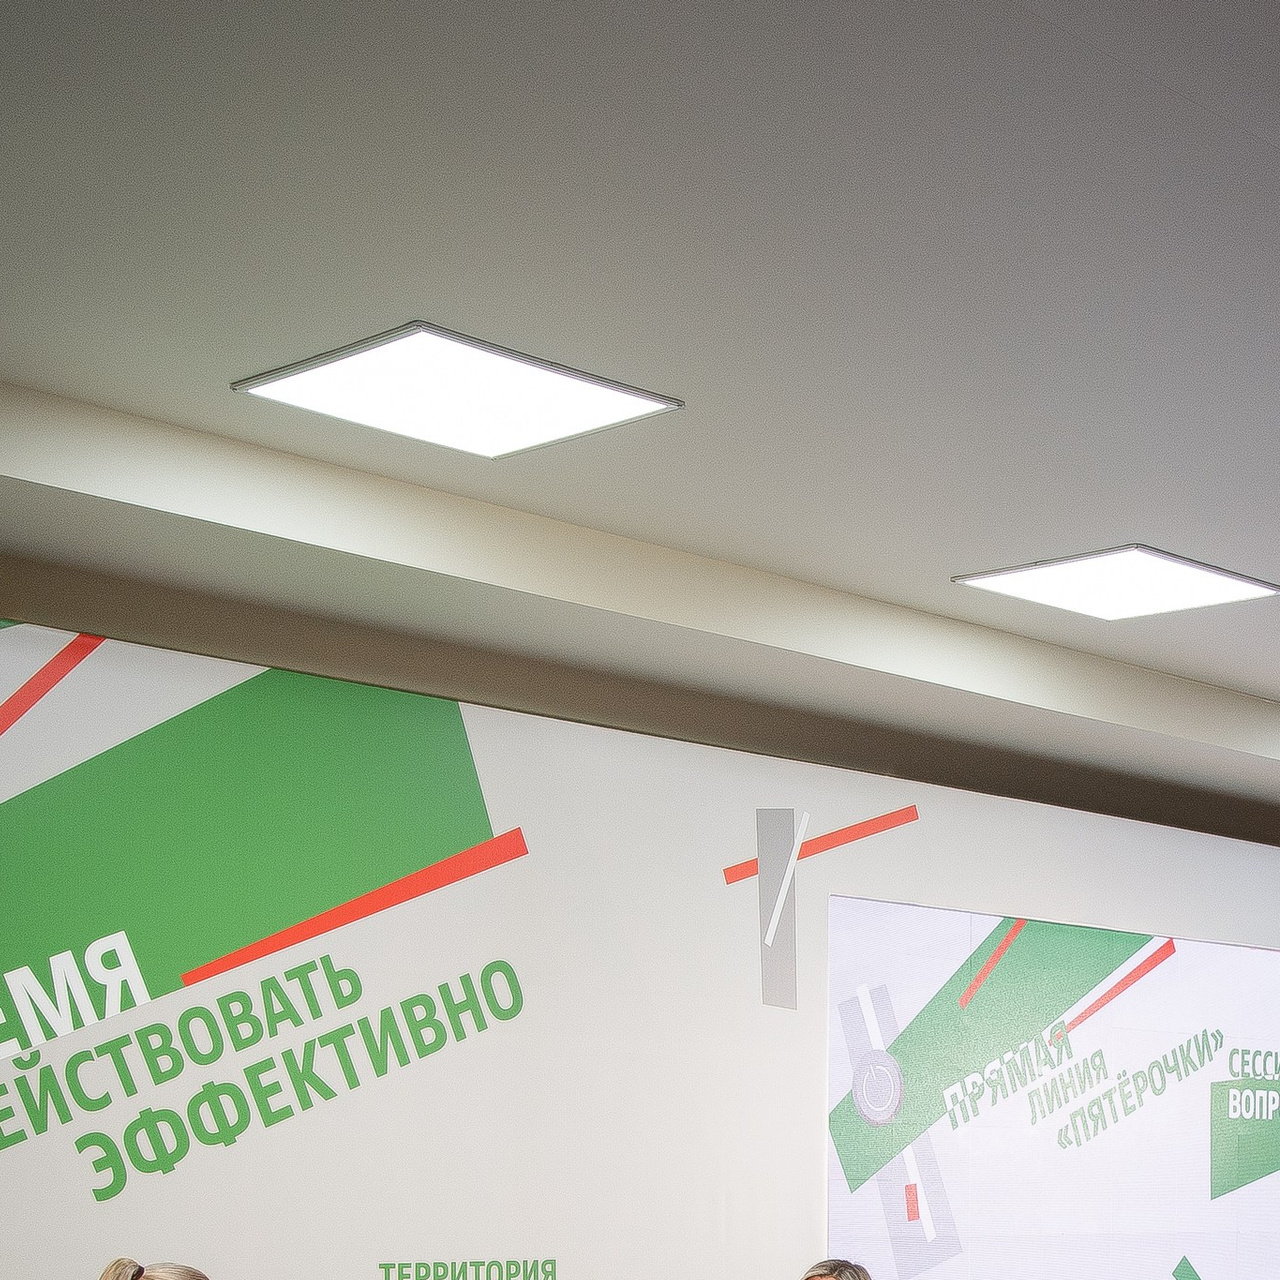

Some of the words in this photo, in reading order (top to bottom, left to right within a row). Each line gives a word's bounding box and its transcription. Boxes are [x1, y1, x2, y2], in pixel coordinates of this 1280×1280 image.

[74, 959, 524, 1202] ЭФФЕКТИВНО
[942, 1020, 1073, 1131] ПРЯМАЯ
[1027, 1048, 1109, 1126] ЛИНИЯ
[1057, 1028, 1224, 1149] «ПЯТЁРОЧКИ»
